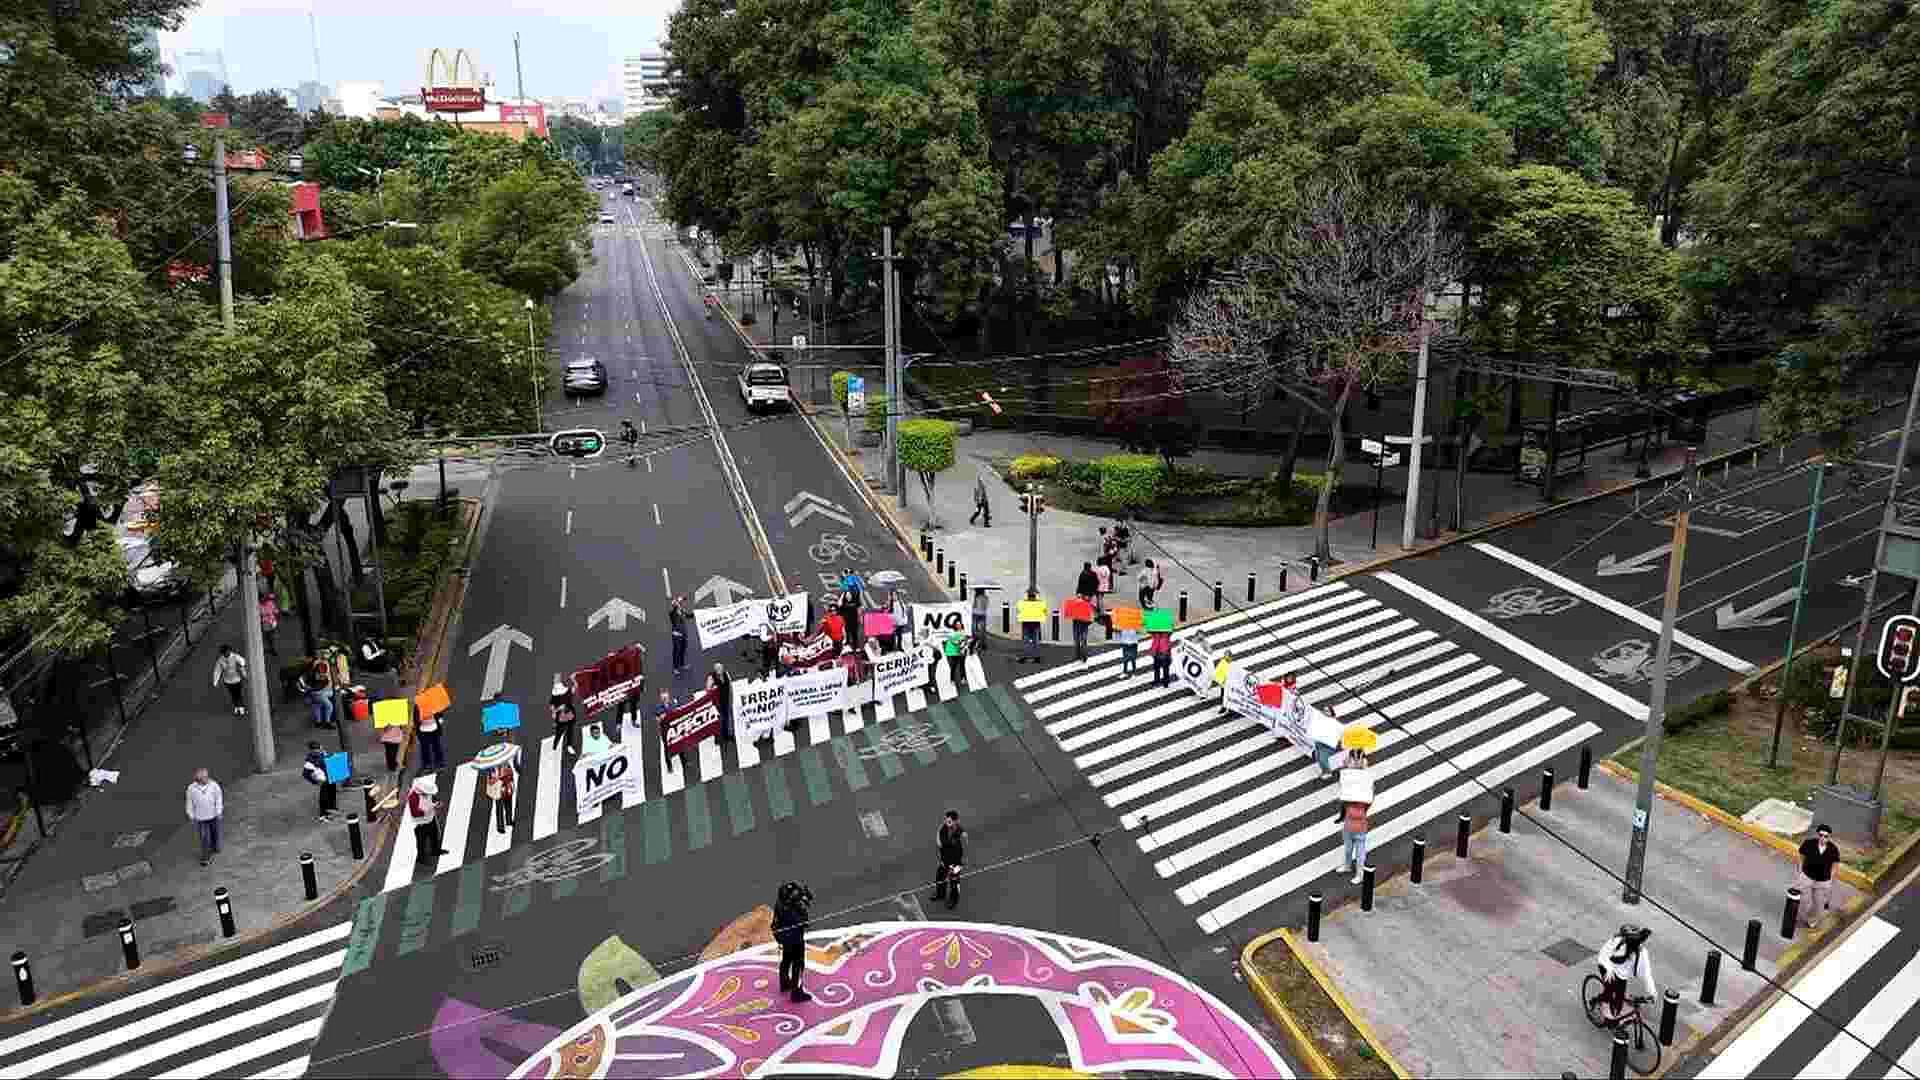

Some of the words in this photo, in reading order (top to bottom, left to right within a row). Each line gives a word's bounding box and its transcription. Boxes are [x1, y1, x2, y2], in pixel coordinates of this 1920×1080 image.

[923, 612, 962, 630] NO
[667, 705, 721, 741] AFECTA
[586, 756, 628, 792] NO
